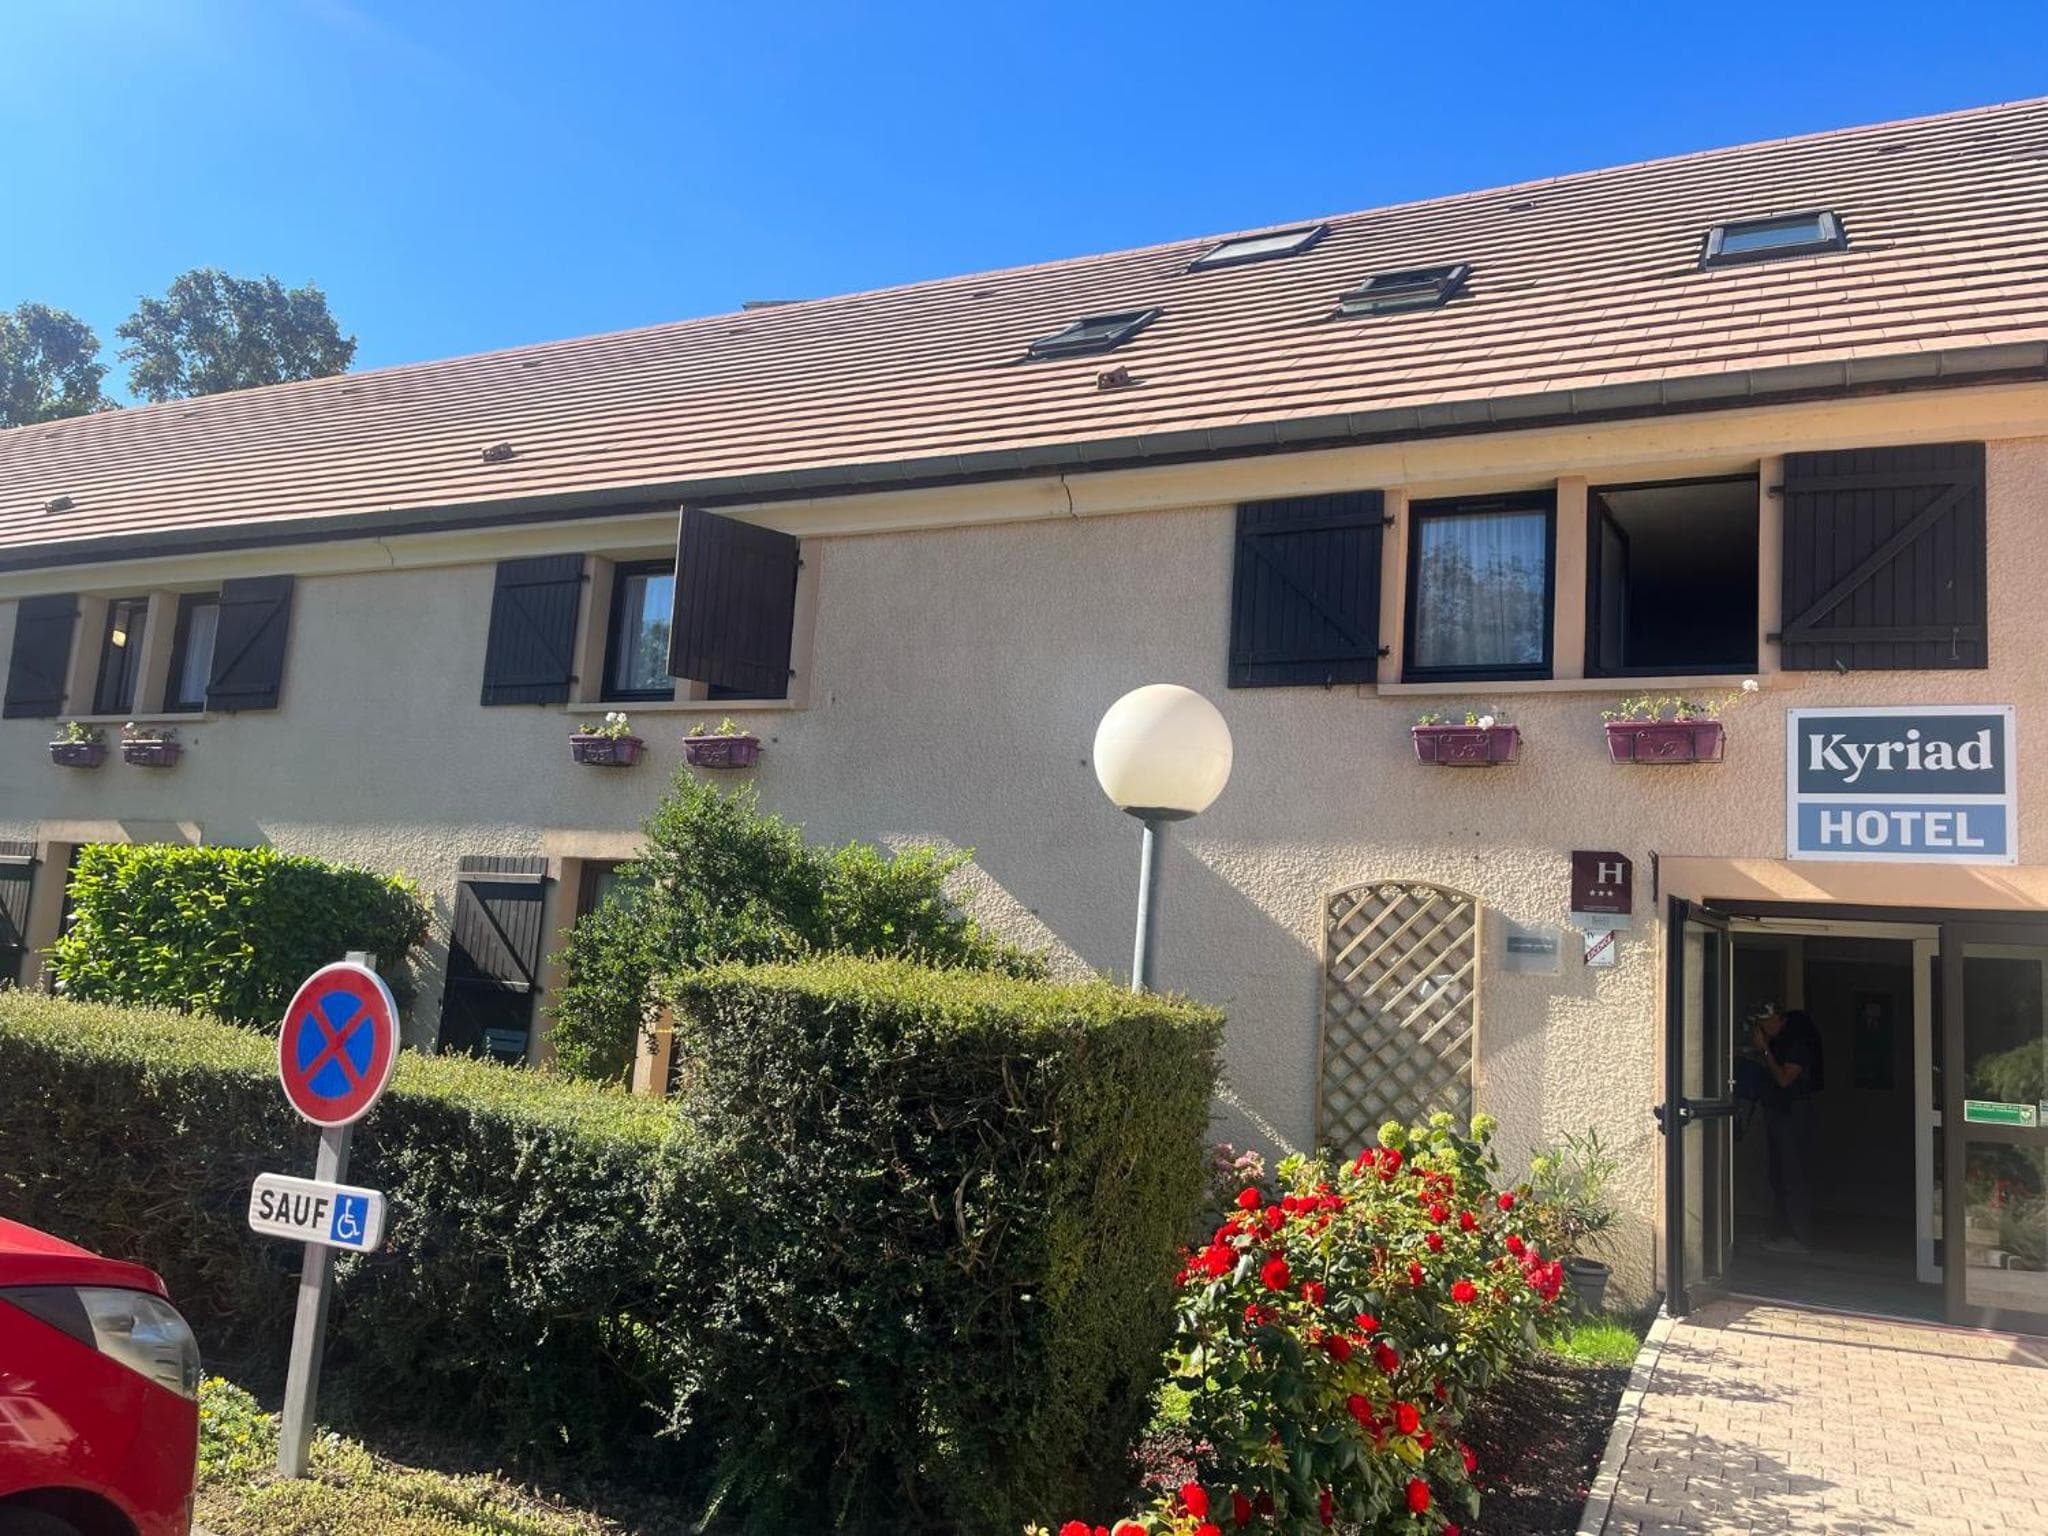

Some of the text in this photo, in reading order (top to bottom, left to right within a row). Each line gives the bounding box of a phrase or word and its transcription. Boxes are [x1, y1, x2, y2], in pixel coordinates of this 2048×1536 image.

[1808, 729, 1994, 783] Kyriad
[1820, 810, 1985, 847] HOTEL
[1598, 862, 1623, 884] H
[259, 1190, 329, 1228] SAUF
